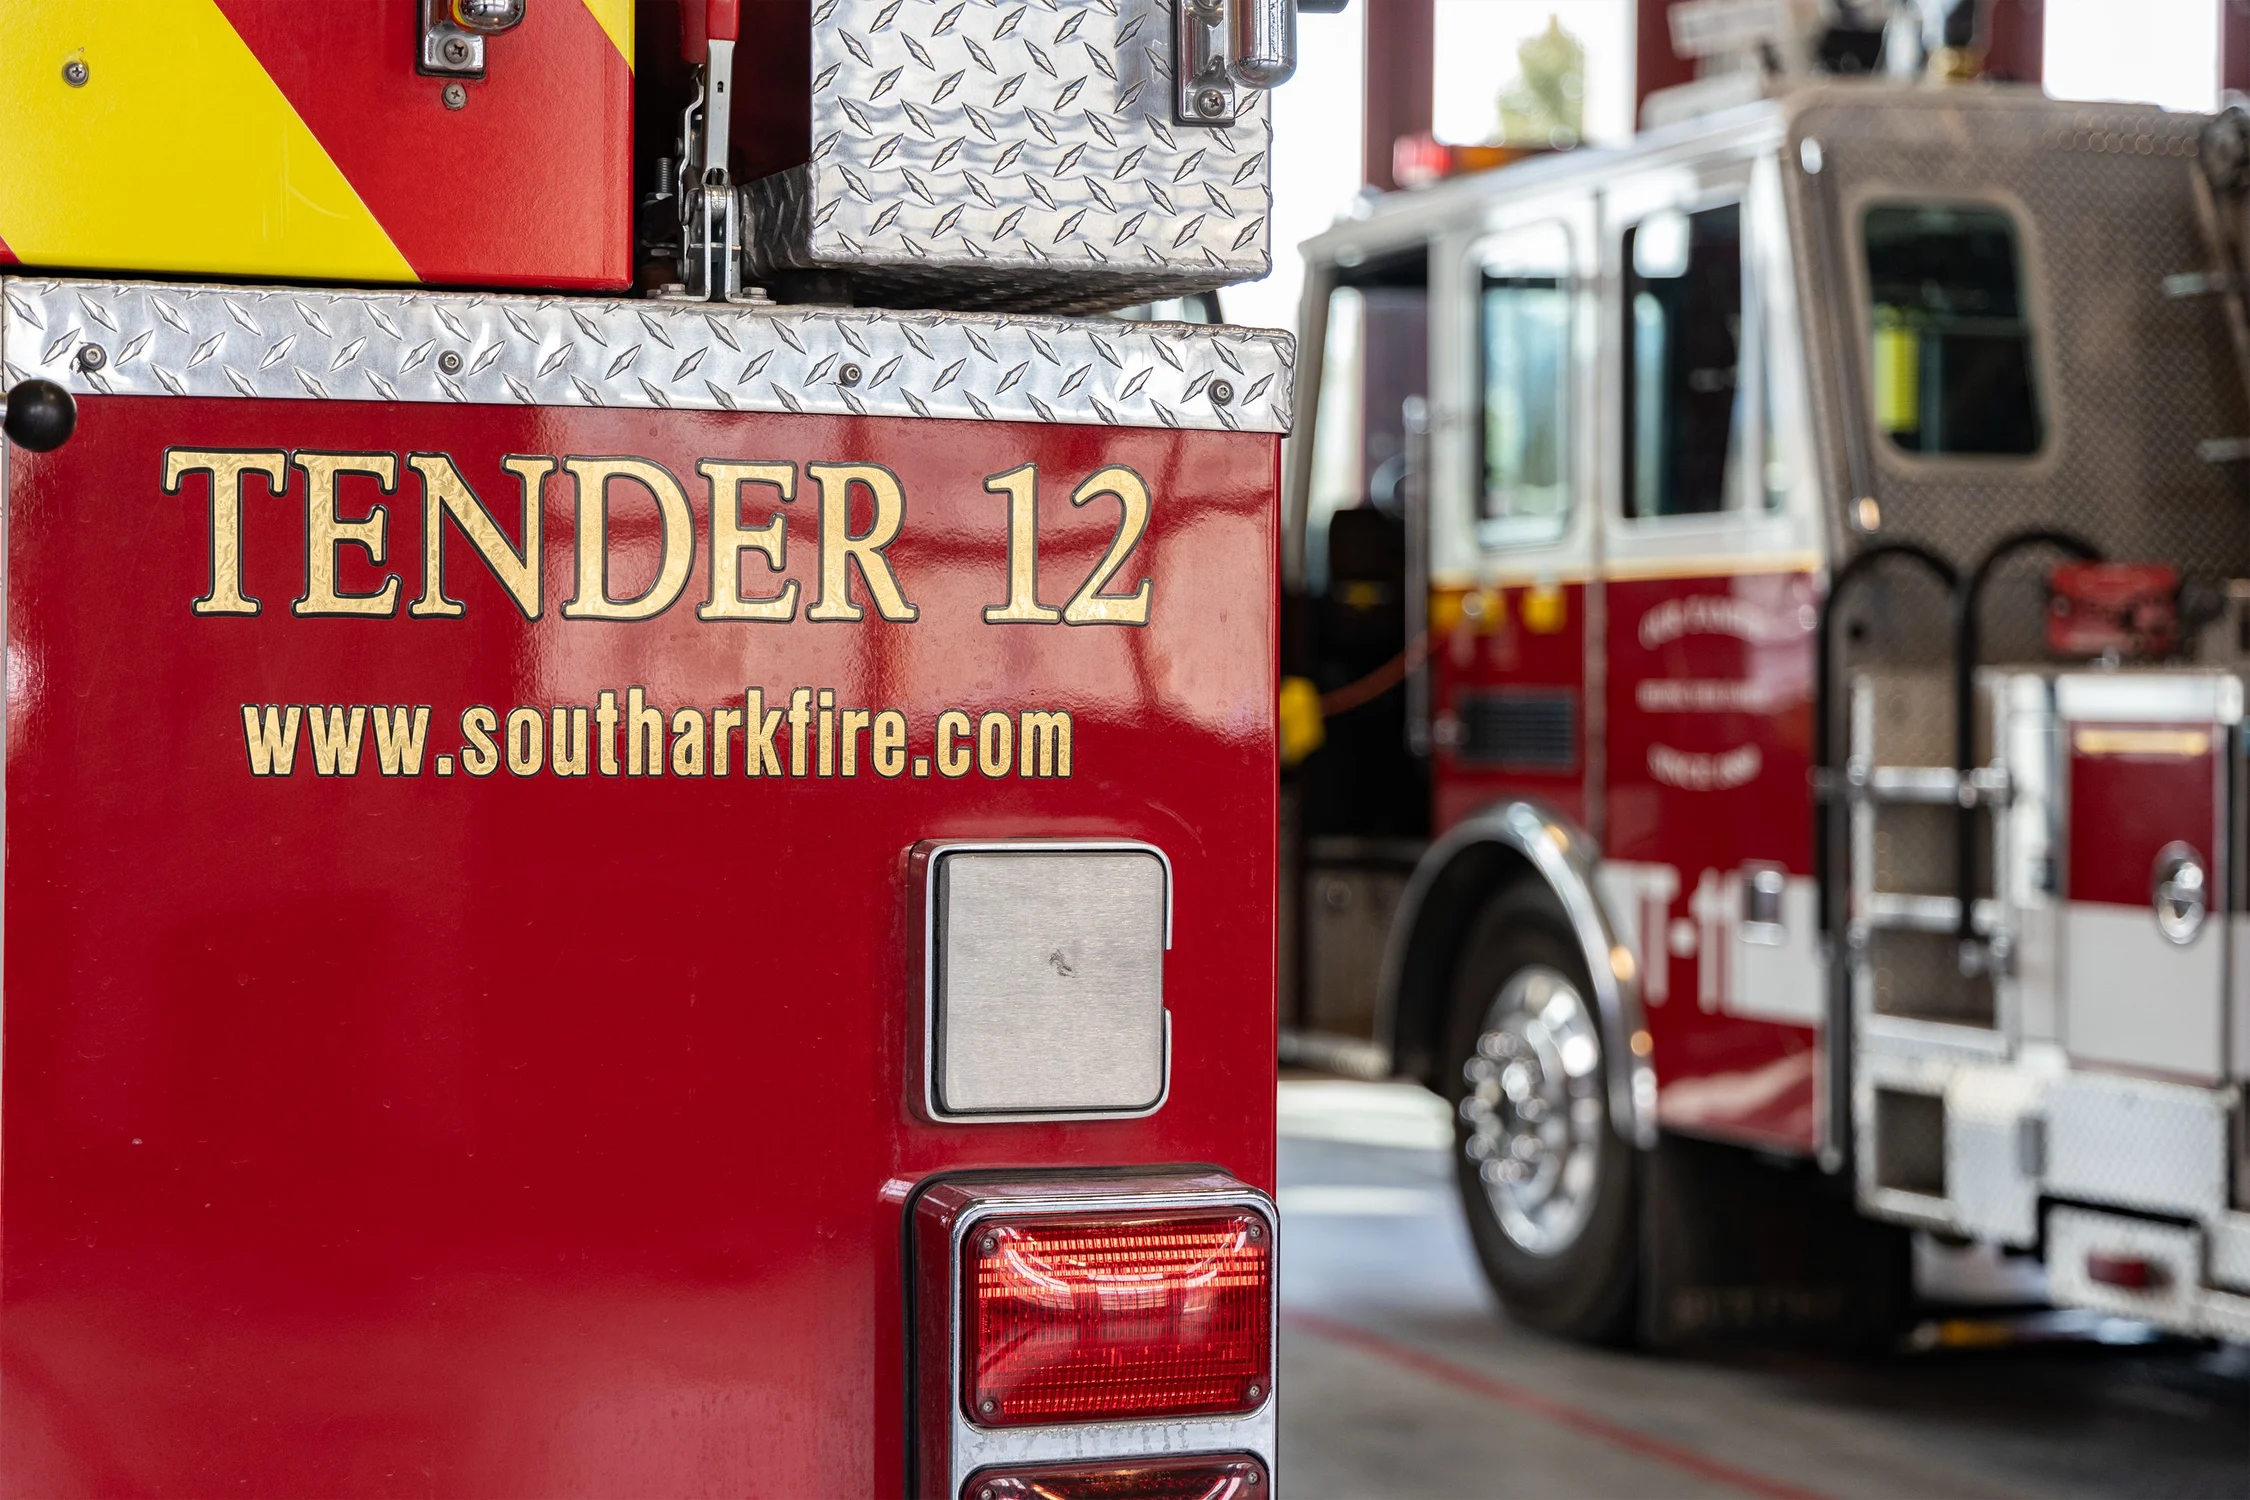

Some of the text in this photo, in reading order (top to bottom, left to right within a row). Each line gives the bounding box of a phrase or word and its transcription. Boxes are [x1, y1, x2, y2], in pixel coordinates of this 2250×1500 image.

[161, 446, 1154, 627] TENDER 12
[241, 685, 1075, 779] www.southarkfire.com
